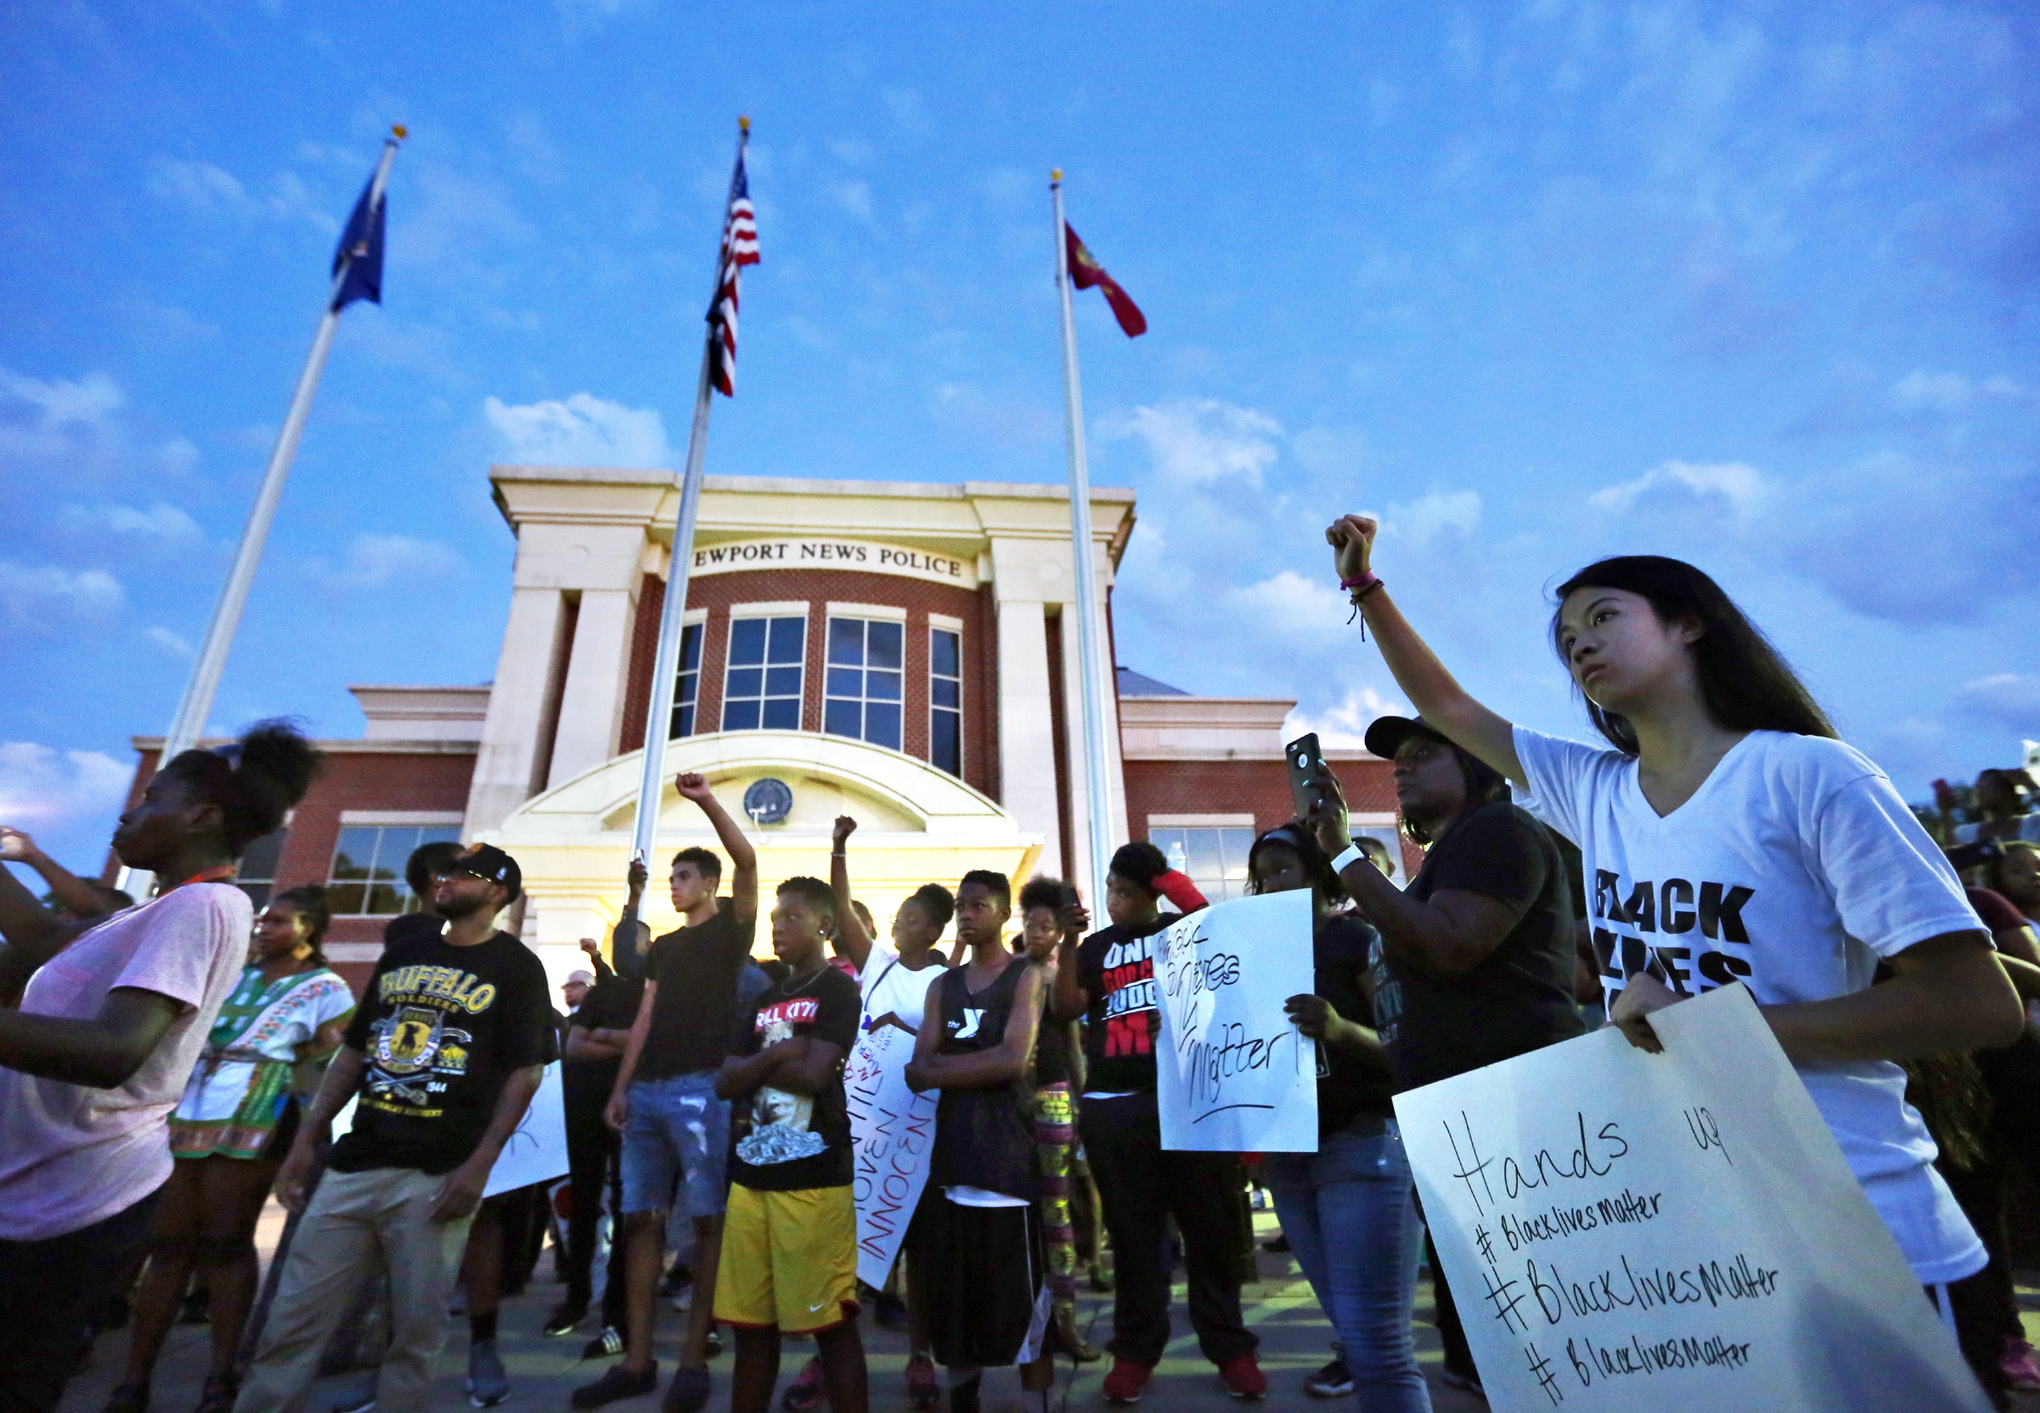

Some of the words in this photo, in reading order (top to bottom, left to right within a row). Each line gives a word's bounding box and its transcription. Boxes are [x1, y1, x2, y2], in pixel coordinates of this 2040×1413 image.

[692, 543, 788, 568] EWPORT
[800, 543, 867, 562] NEWS
[879, 549, 962, 577] POLICE
[378, 964, 497, 1015] BUFFALO
[387, 994, 460, 1014] SOLDIERS
[853, 1108, 899, 1211] OVEN
[857, 1092, 939, 1261] INNOCENT
[1443, 1110, 1629, 1217] Hands
